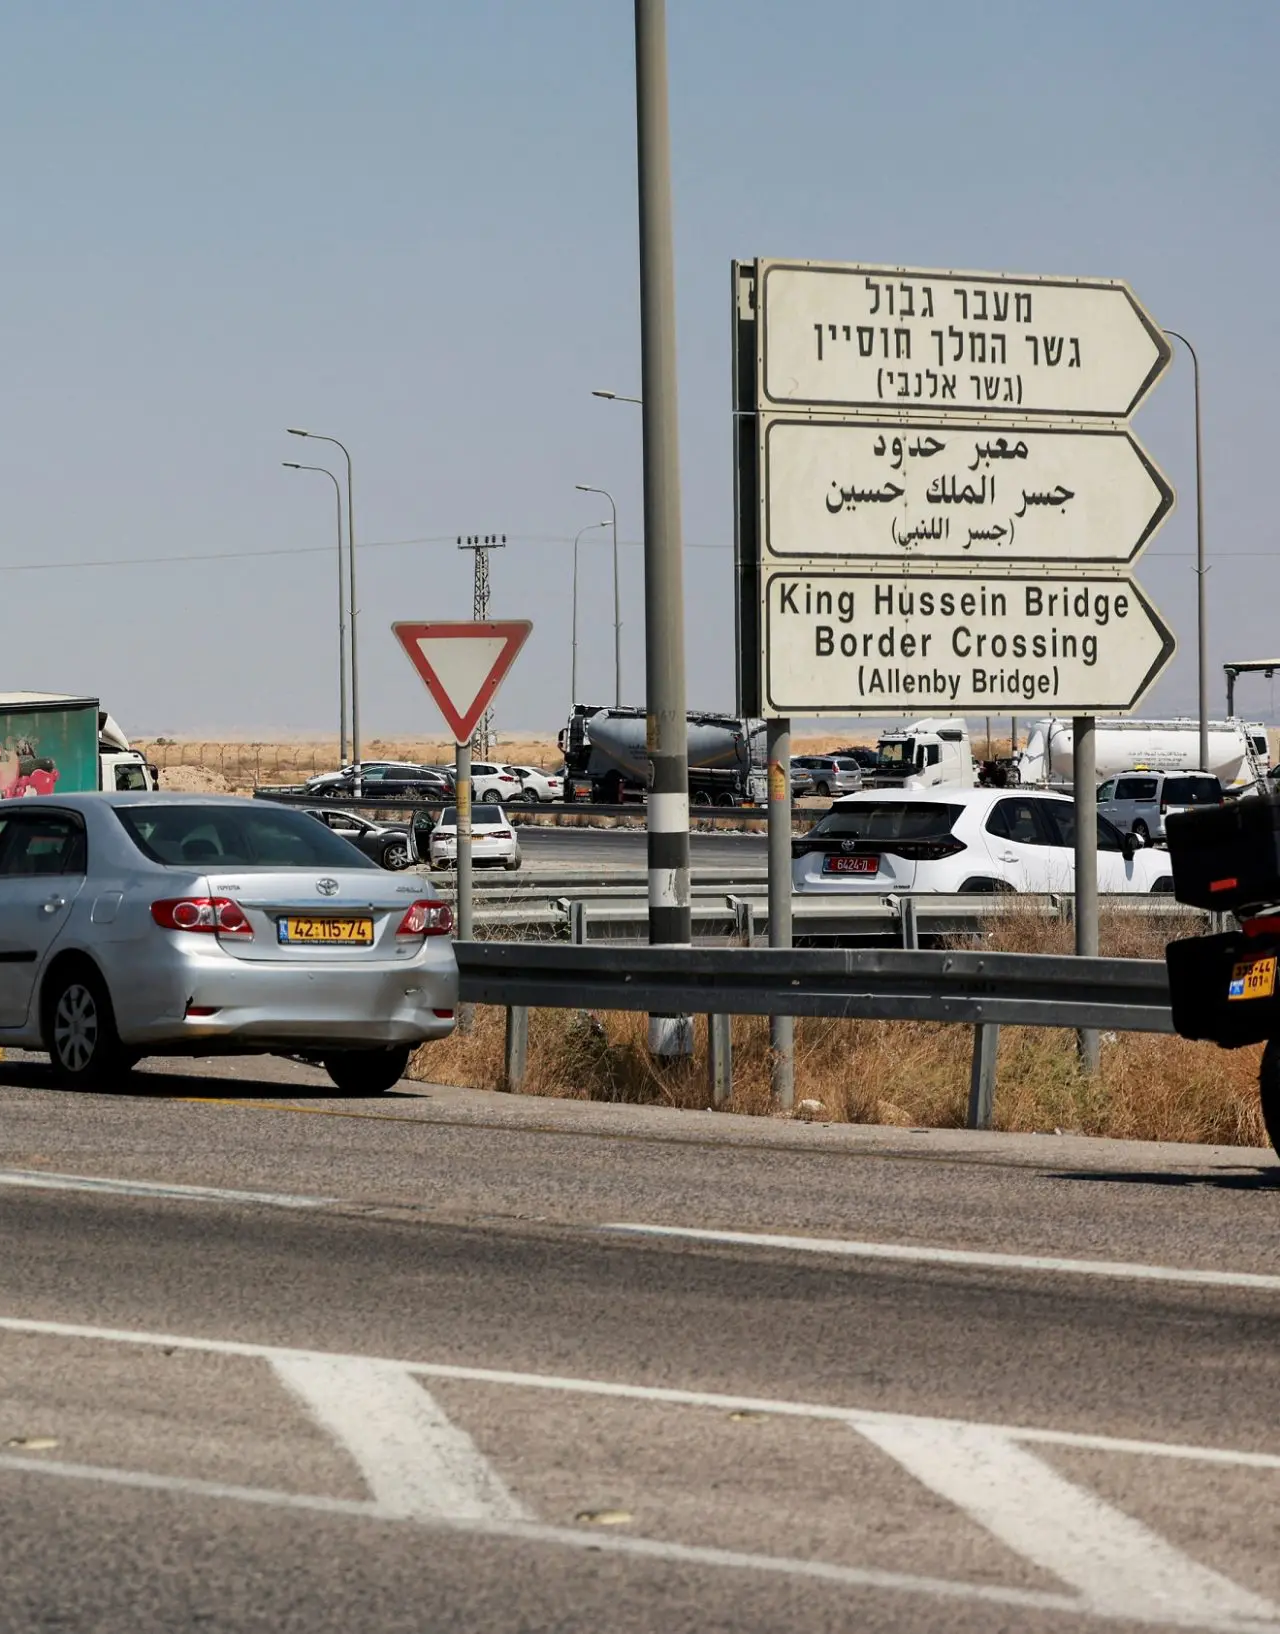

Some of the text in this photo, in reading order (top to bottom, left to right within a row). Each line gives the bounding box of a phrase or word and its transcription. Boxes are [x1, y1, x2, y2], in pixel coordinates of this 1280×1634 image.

[865, 277, 1033, 323] מעבר גבול
[813, 323, 1082, 368] גשר המלך חוסיין
[876, 368, 1023, 405] (גשר אלנבי)
[873, 435, 1029, 471] معبر حدود
[825, 474, 1076, 517] جسر الملك حسين
[891, 516, 1015, 550] (جسر اللنبي)
[779, 583, 1130, 626] King Hussein Bridge
[814, 625, 1099, 666] Border Crossing
[857, 666, 1060, 706] (Allenby Bridge)
